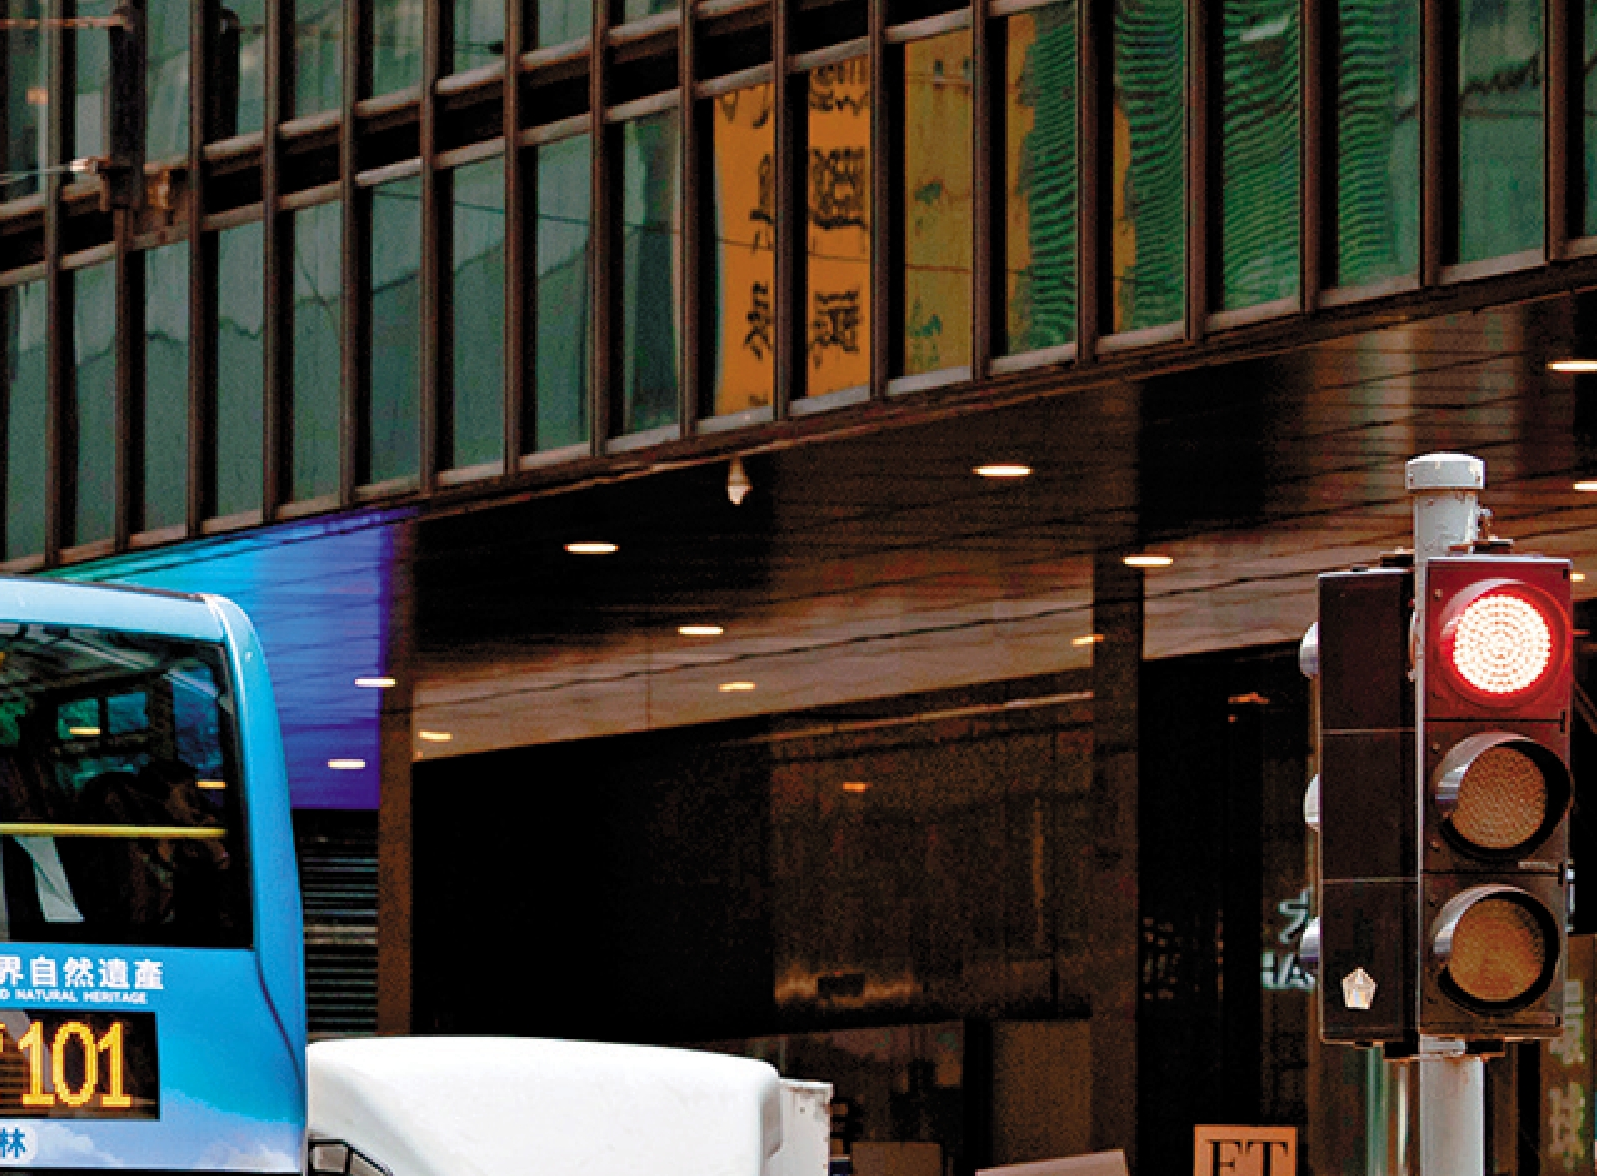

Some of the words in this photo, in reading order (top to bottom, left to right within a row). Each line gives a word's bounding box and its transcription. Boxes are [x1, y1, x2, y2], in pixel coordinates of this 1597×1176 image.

[14, 987, 79, 1003] NATURAL
[82, 990, 149, 1005] HERITAGE
[17, 1021, 134, 1108] 101
